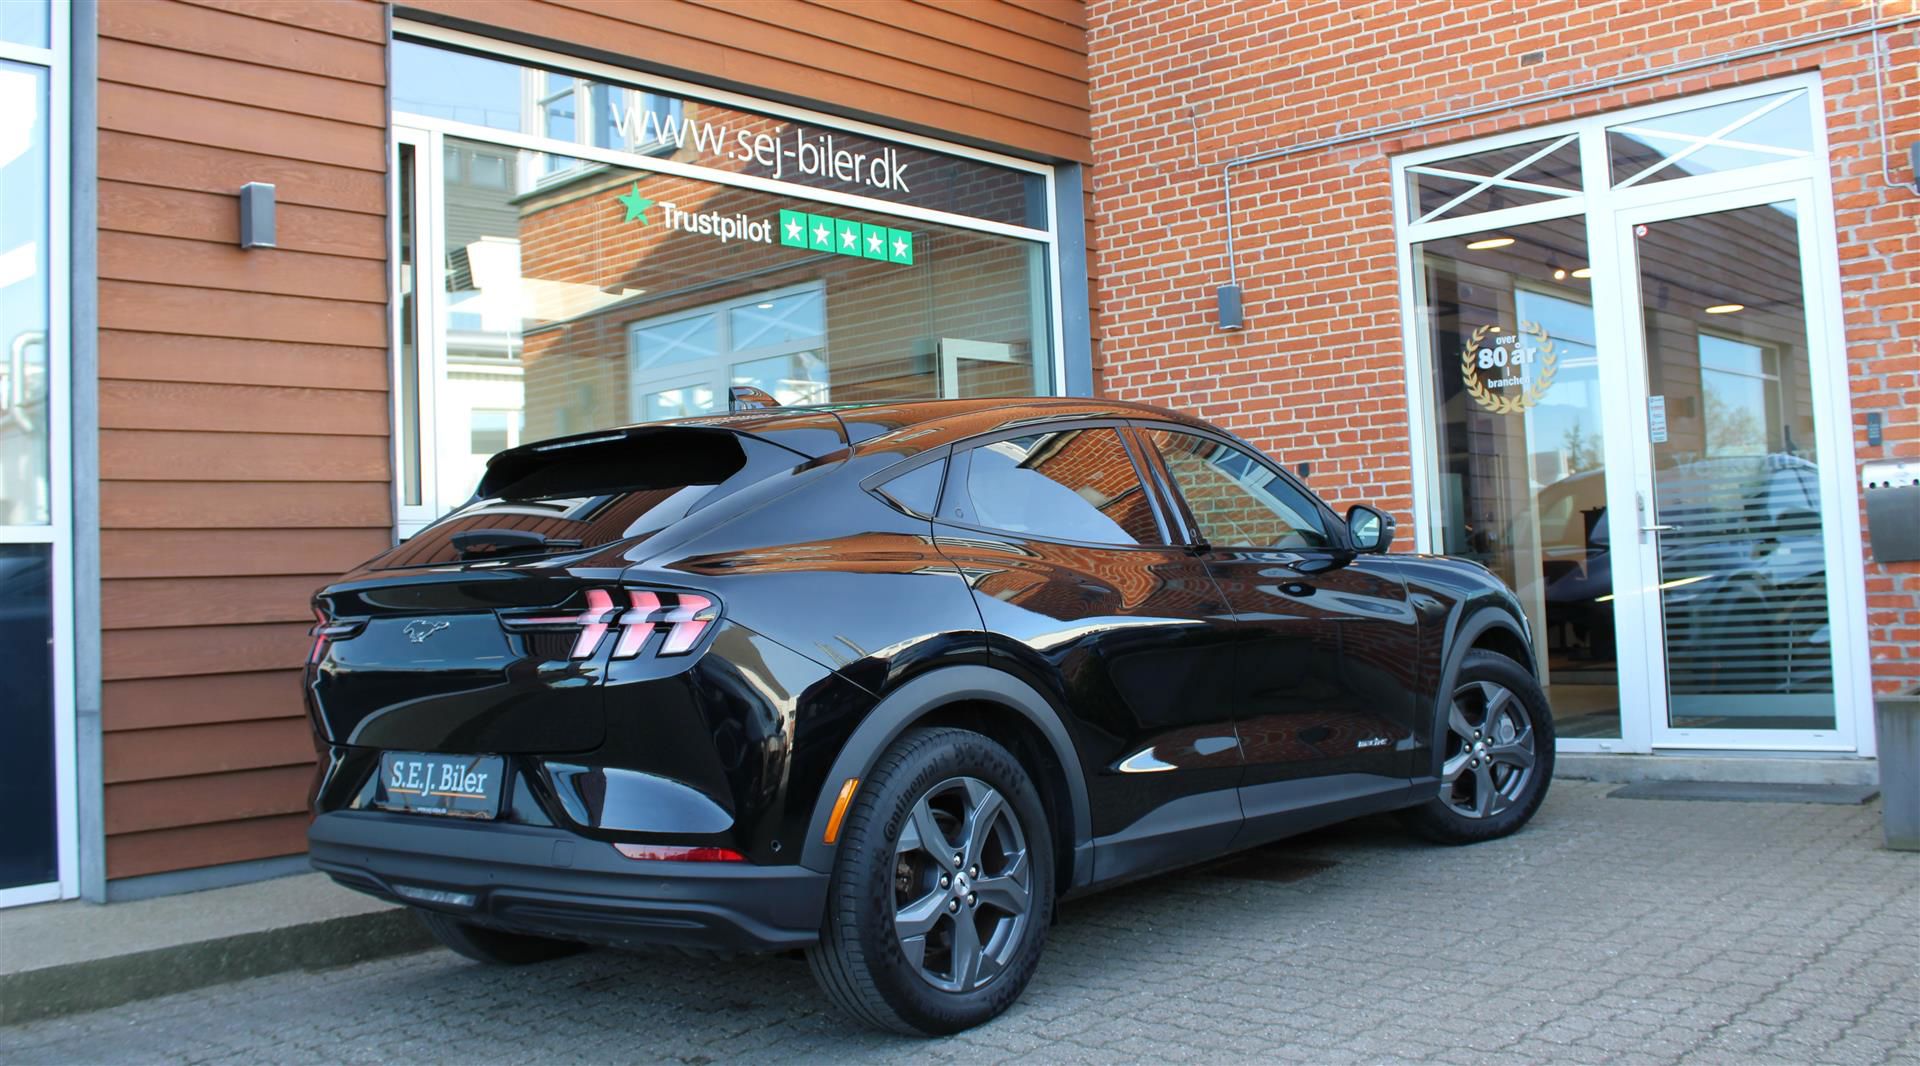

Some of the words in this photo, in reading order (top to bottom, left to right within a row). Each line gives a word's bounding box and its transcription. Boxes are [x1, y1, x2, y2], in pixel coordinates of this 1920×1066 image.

[610, 101, 910, 193] www.sej-biler.dk
[658, 201, 772, 244] Trustpilot
[1478, 346, 1508, 369] 80
[1511, 342, 1537, 365] år
[1496, 336, 1517, 345] over
[391, 761, 436, 797] S.E.J.
[439, 763, 488, 793] Biler
[884, 758, 938, 841] Continental
